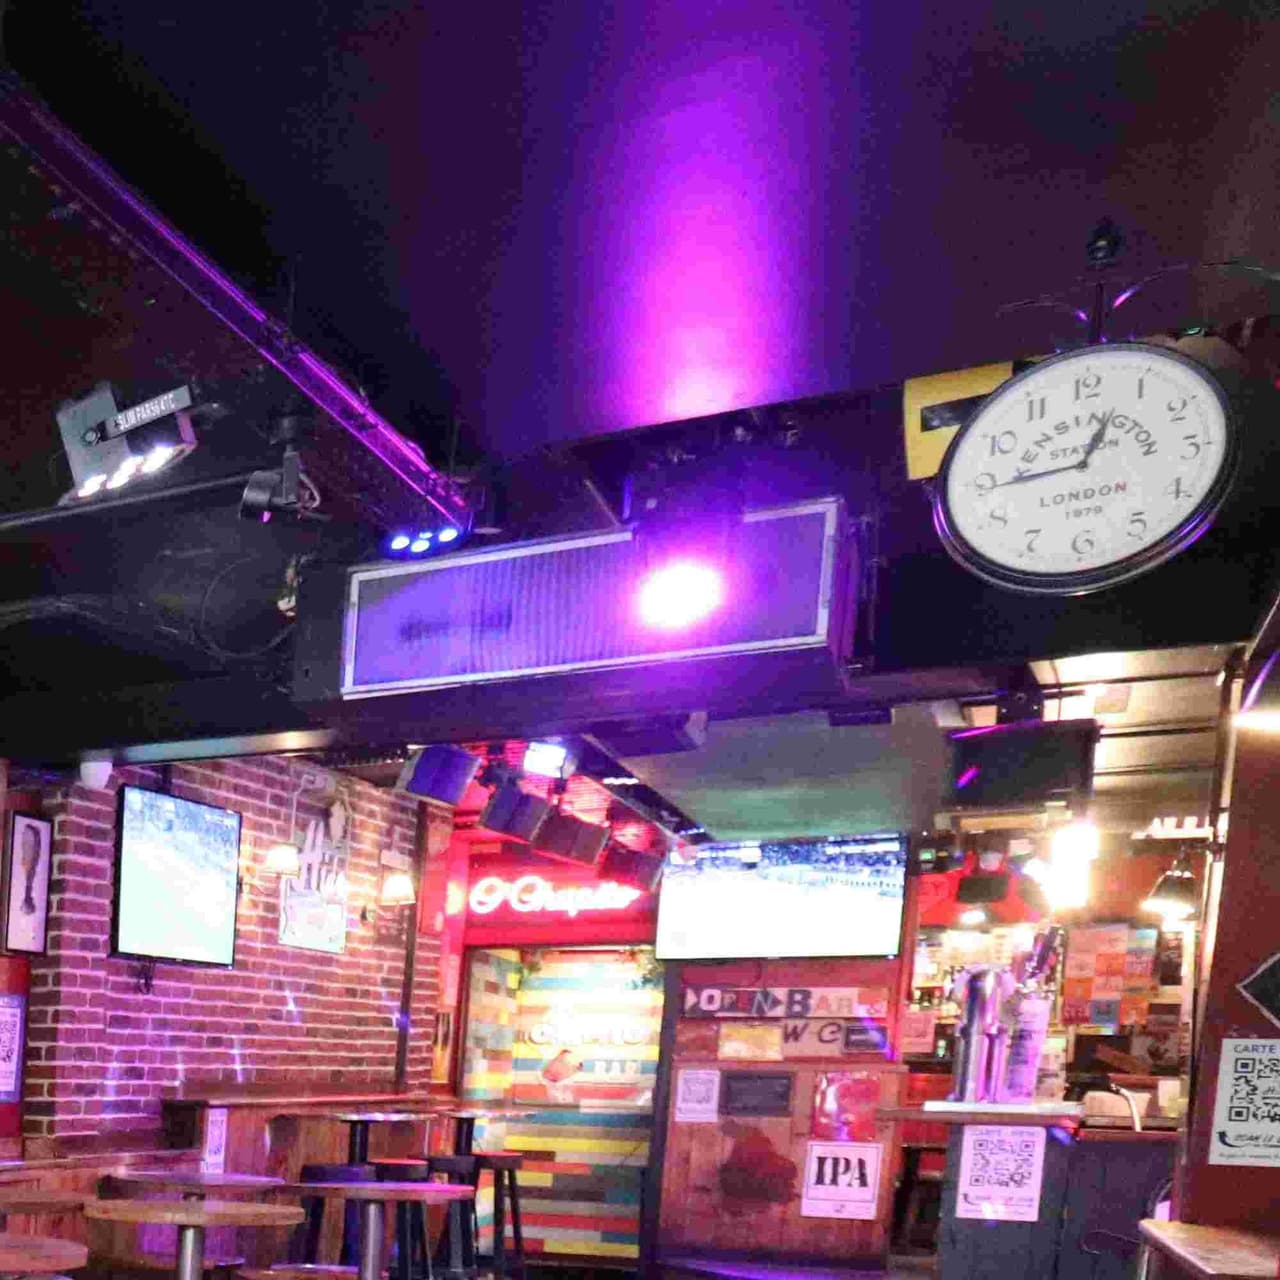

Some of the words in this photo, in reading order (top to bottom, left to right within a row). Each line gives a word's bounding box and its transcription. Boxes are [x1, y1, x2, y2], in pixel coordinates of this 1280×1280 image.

[1073, 374, 1102, 400] 12
[1026, 396, 1046, 422] 11
[1167, 397, 1188, 422] 2
[990, 429, 1017, 457] 10
[1012, 411, 1158, 480] KENSINGTON
[1039, 481, 1128, 507] LONDON
[1071, 530, 1094, 555] 6
[1233, 1043, 1276, 1055] CARTE
[813, 1155, 870, 1188] IPA
